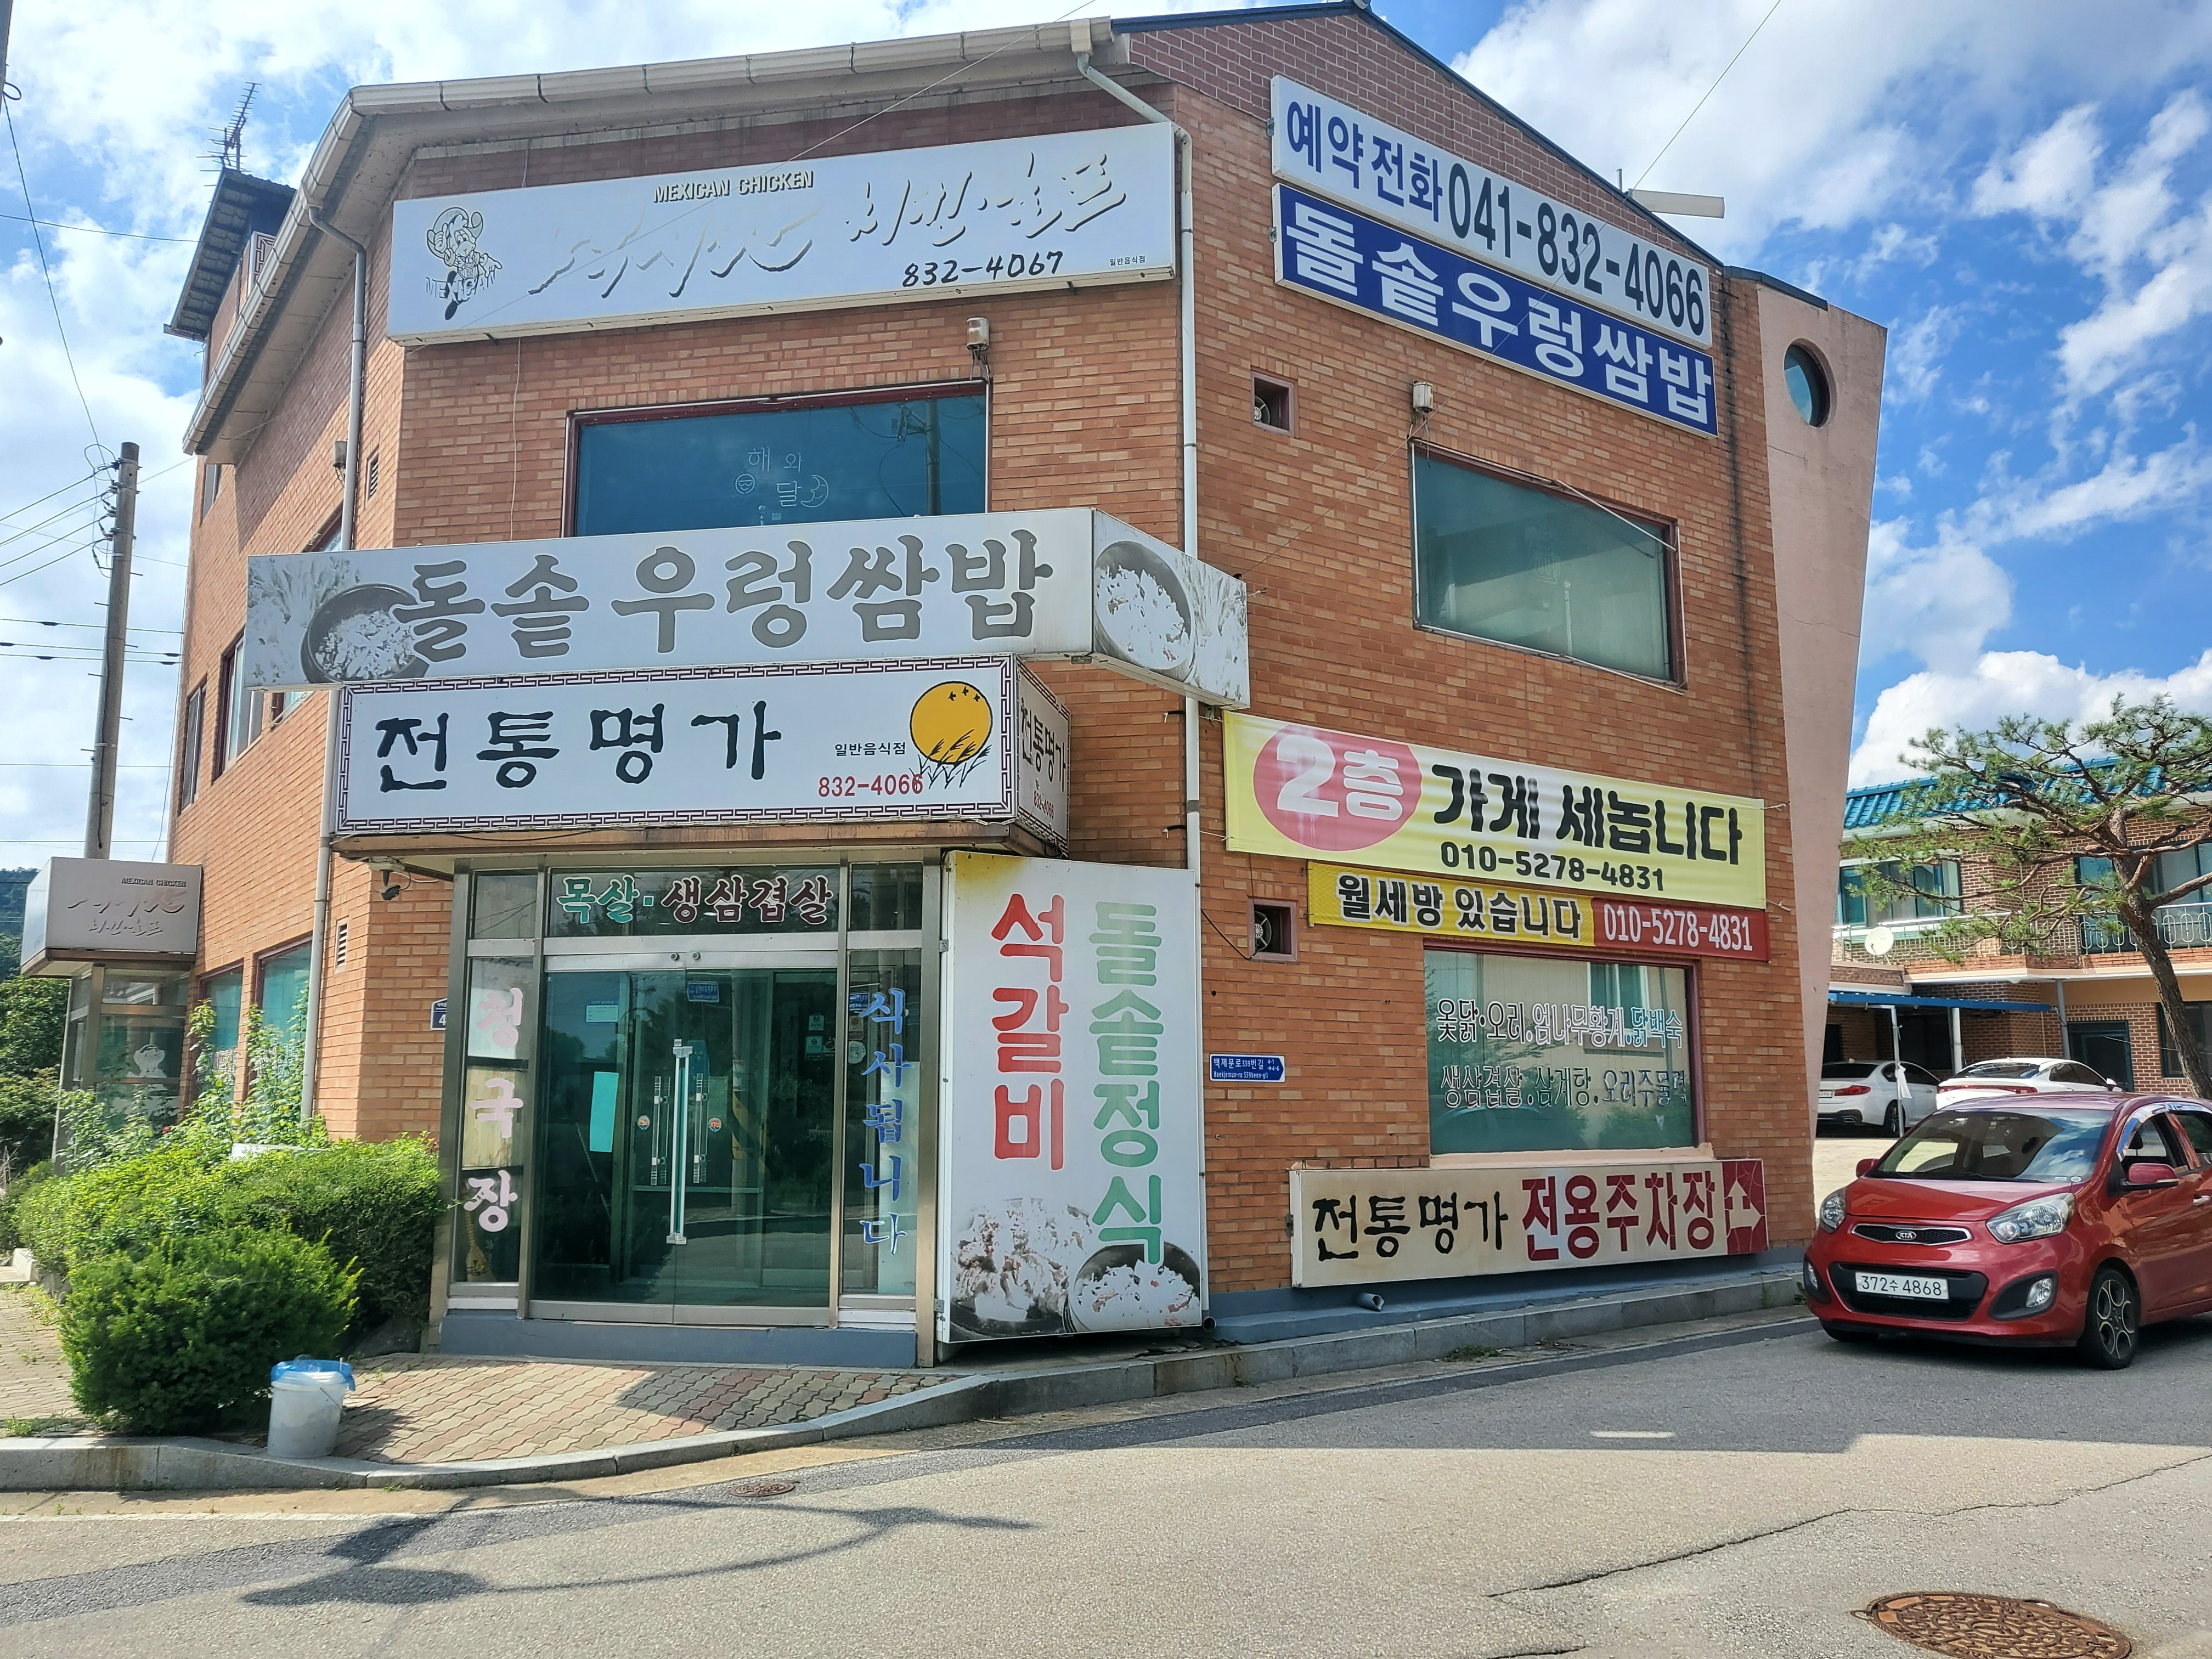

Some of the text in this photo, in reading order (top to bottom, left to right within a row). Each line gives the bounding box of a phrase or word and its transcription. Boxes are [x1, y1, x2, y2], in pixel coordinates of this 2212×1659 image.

[653, 171, 814, 203] MEXICAN CHICKEN
[1287, 101, 1704, 336] 예약전화 041-832-4066
[902, 251, 1063, 287] 832-4067
[1109, 255, 1146, 266] 일반음식점
[1286, 201, 1712, 425] 돌솥우렁쌈밥
[776, 480, 803, 507] 달
[392, 529, 1053, 662] 돌솥우렁쌈밥
[375, 701, 782, 793] 전통명가
[834, 742, 906, 757] 일반음식점
[1020, 697, 1066, 792] 전통명가
[818, 774, 924, 798] 832-4066
[1034, 790, 1054, 820] 832-4066
[1277, 735, 1742, 865] 2층 가게 세놉니다
[121, 877, 153, 885] MEXICAN
[1441, 841, 1664, 892] 010-5278-4831
[1338, 876, 1581, 941] 월세방 있습니다
[1603, 902, 1753, 952] 010-5278-4831
[991, 893, 1069, 1171] 석갈비
[1088, 901, 1164, 1265] 돌솥정식
[1214, 1058, 1264, 1070] 백제문로339번길
[464, 988, 523, 1232] 청국장
[859, 988, 911, 1255] 식사됩니다
[1312, 1170, 1717, 1262] 전통명가 전용주차장
[1861, 1276, 1942, 1296] 372수 4868
